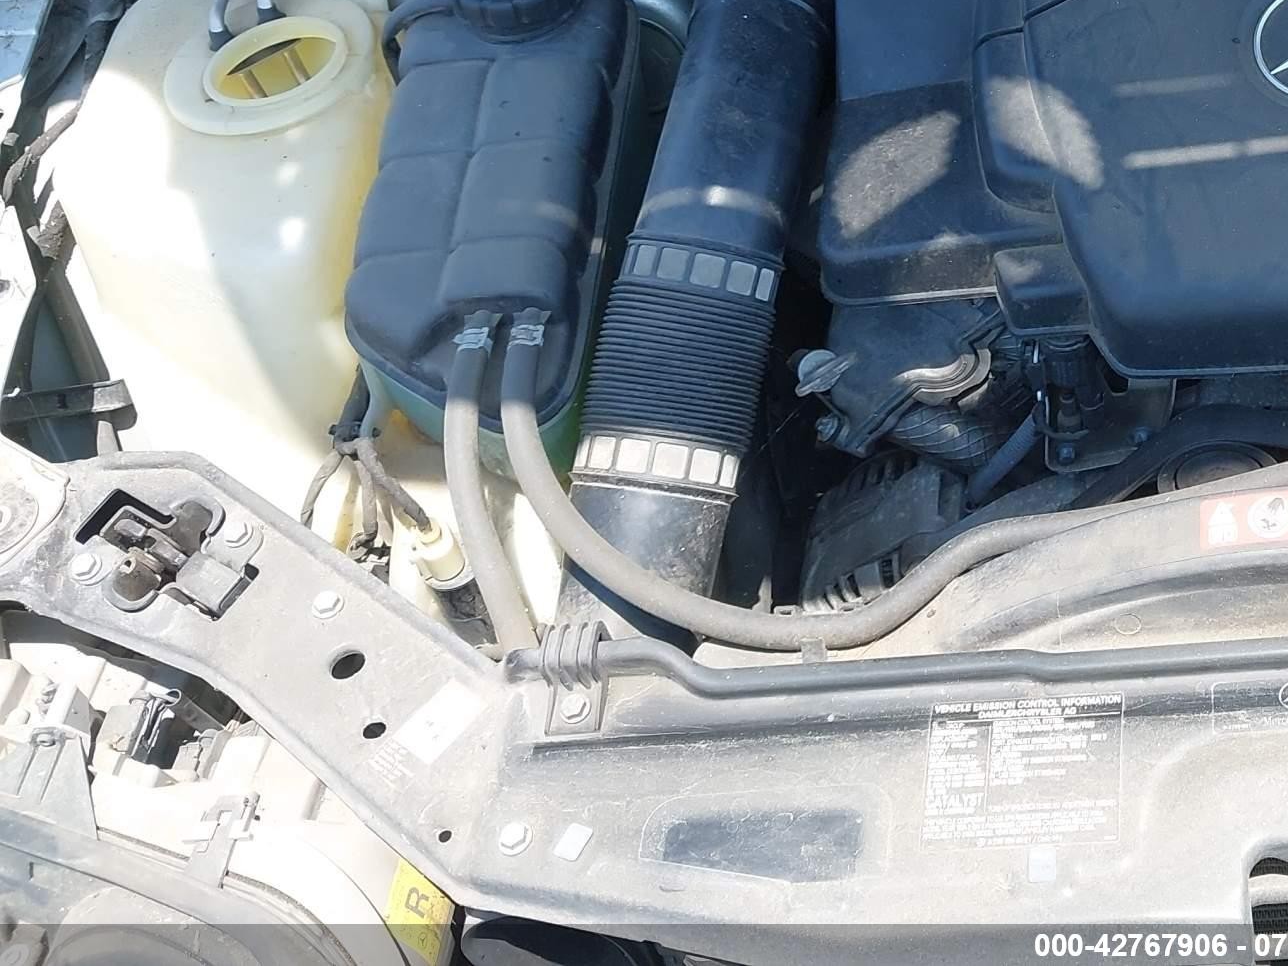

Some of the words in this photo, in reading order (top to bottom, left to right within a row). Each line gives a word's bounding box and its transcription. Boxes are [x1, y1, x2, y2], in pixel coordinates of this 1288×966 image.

[935, 703, 972, 715] VEHICLE
[973, 700, 1016, 712] EMISSION
[1017, 698, 1060, 709] CONTROL
[1061, 694, 1122, 707] INFORMATION
[978, 706, 1062, 719] DAIMLERCHRYSLER
[1064, 706, 1077, 715] AG
[405, 887, 430, 919] R
